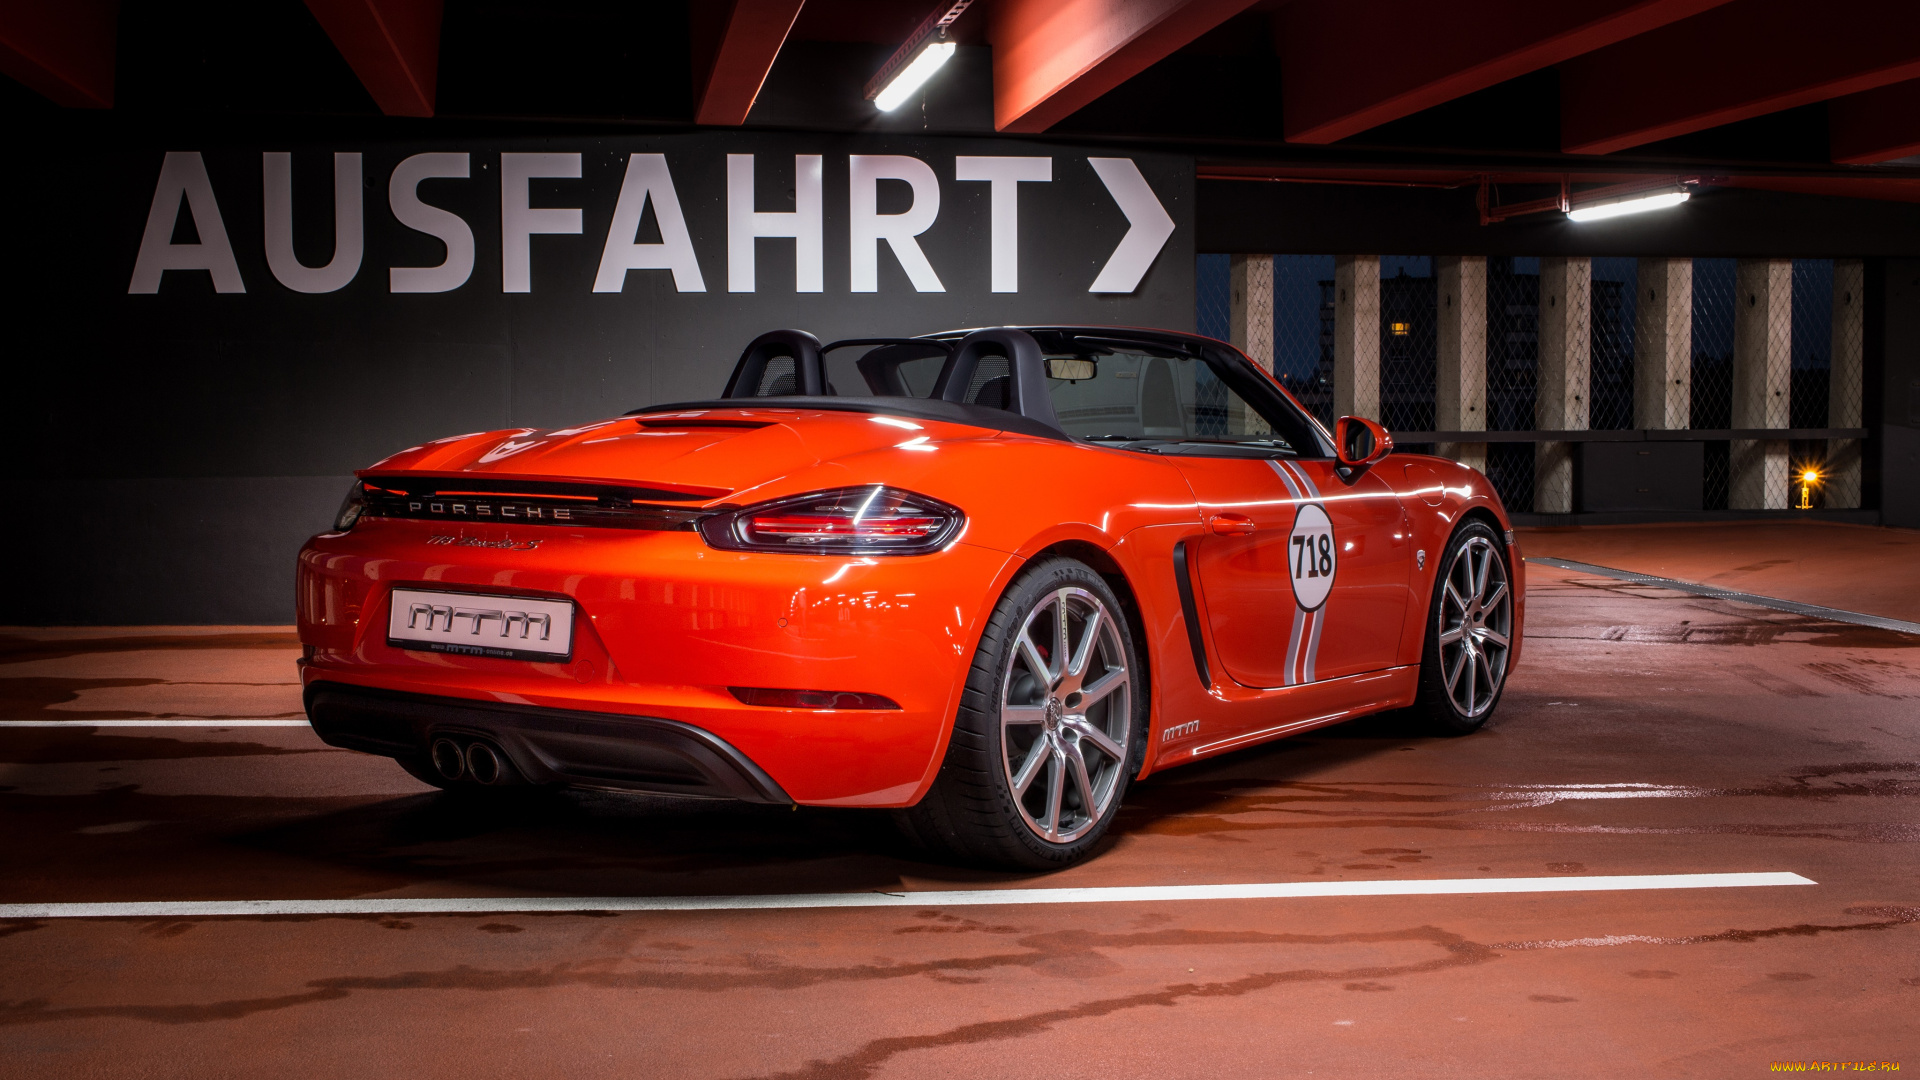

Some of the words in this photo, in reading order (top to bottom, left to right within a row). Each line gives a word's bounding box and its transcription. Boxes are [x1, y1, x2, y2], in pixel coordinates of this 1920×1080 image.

[127, 151, 1053, 295] AUSFAHRT
[409, 502, 571, 519] PORSCHE
[1292, 533, 1332, 579] 718
